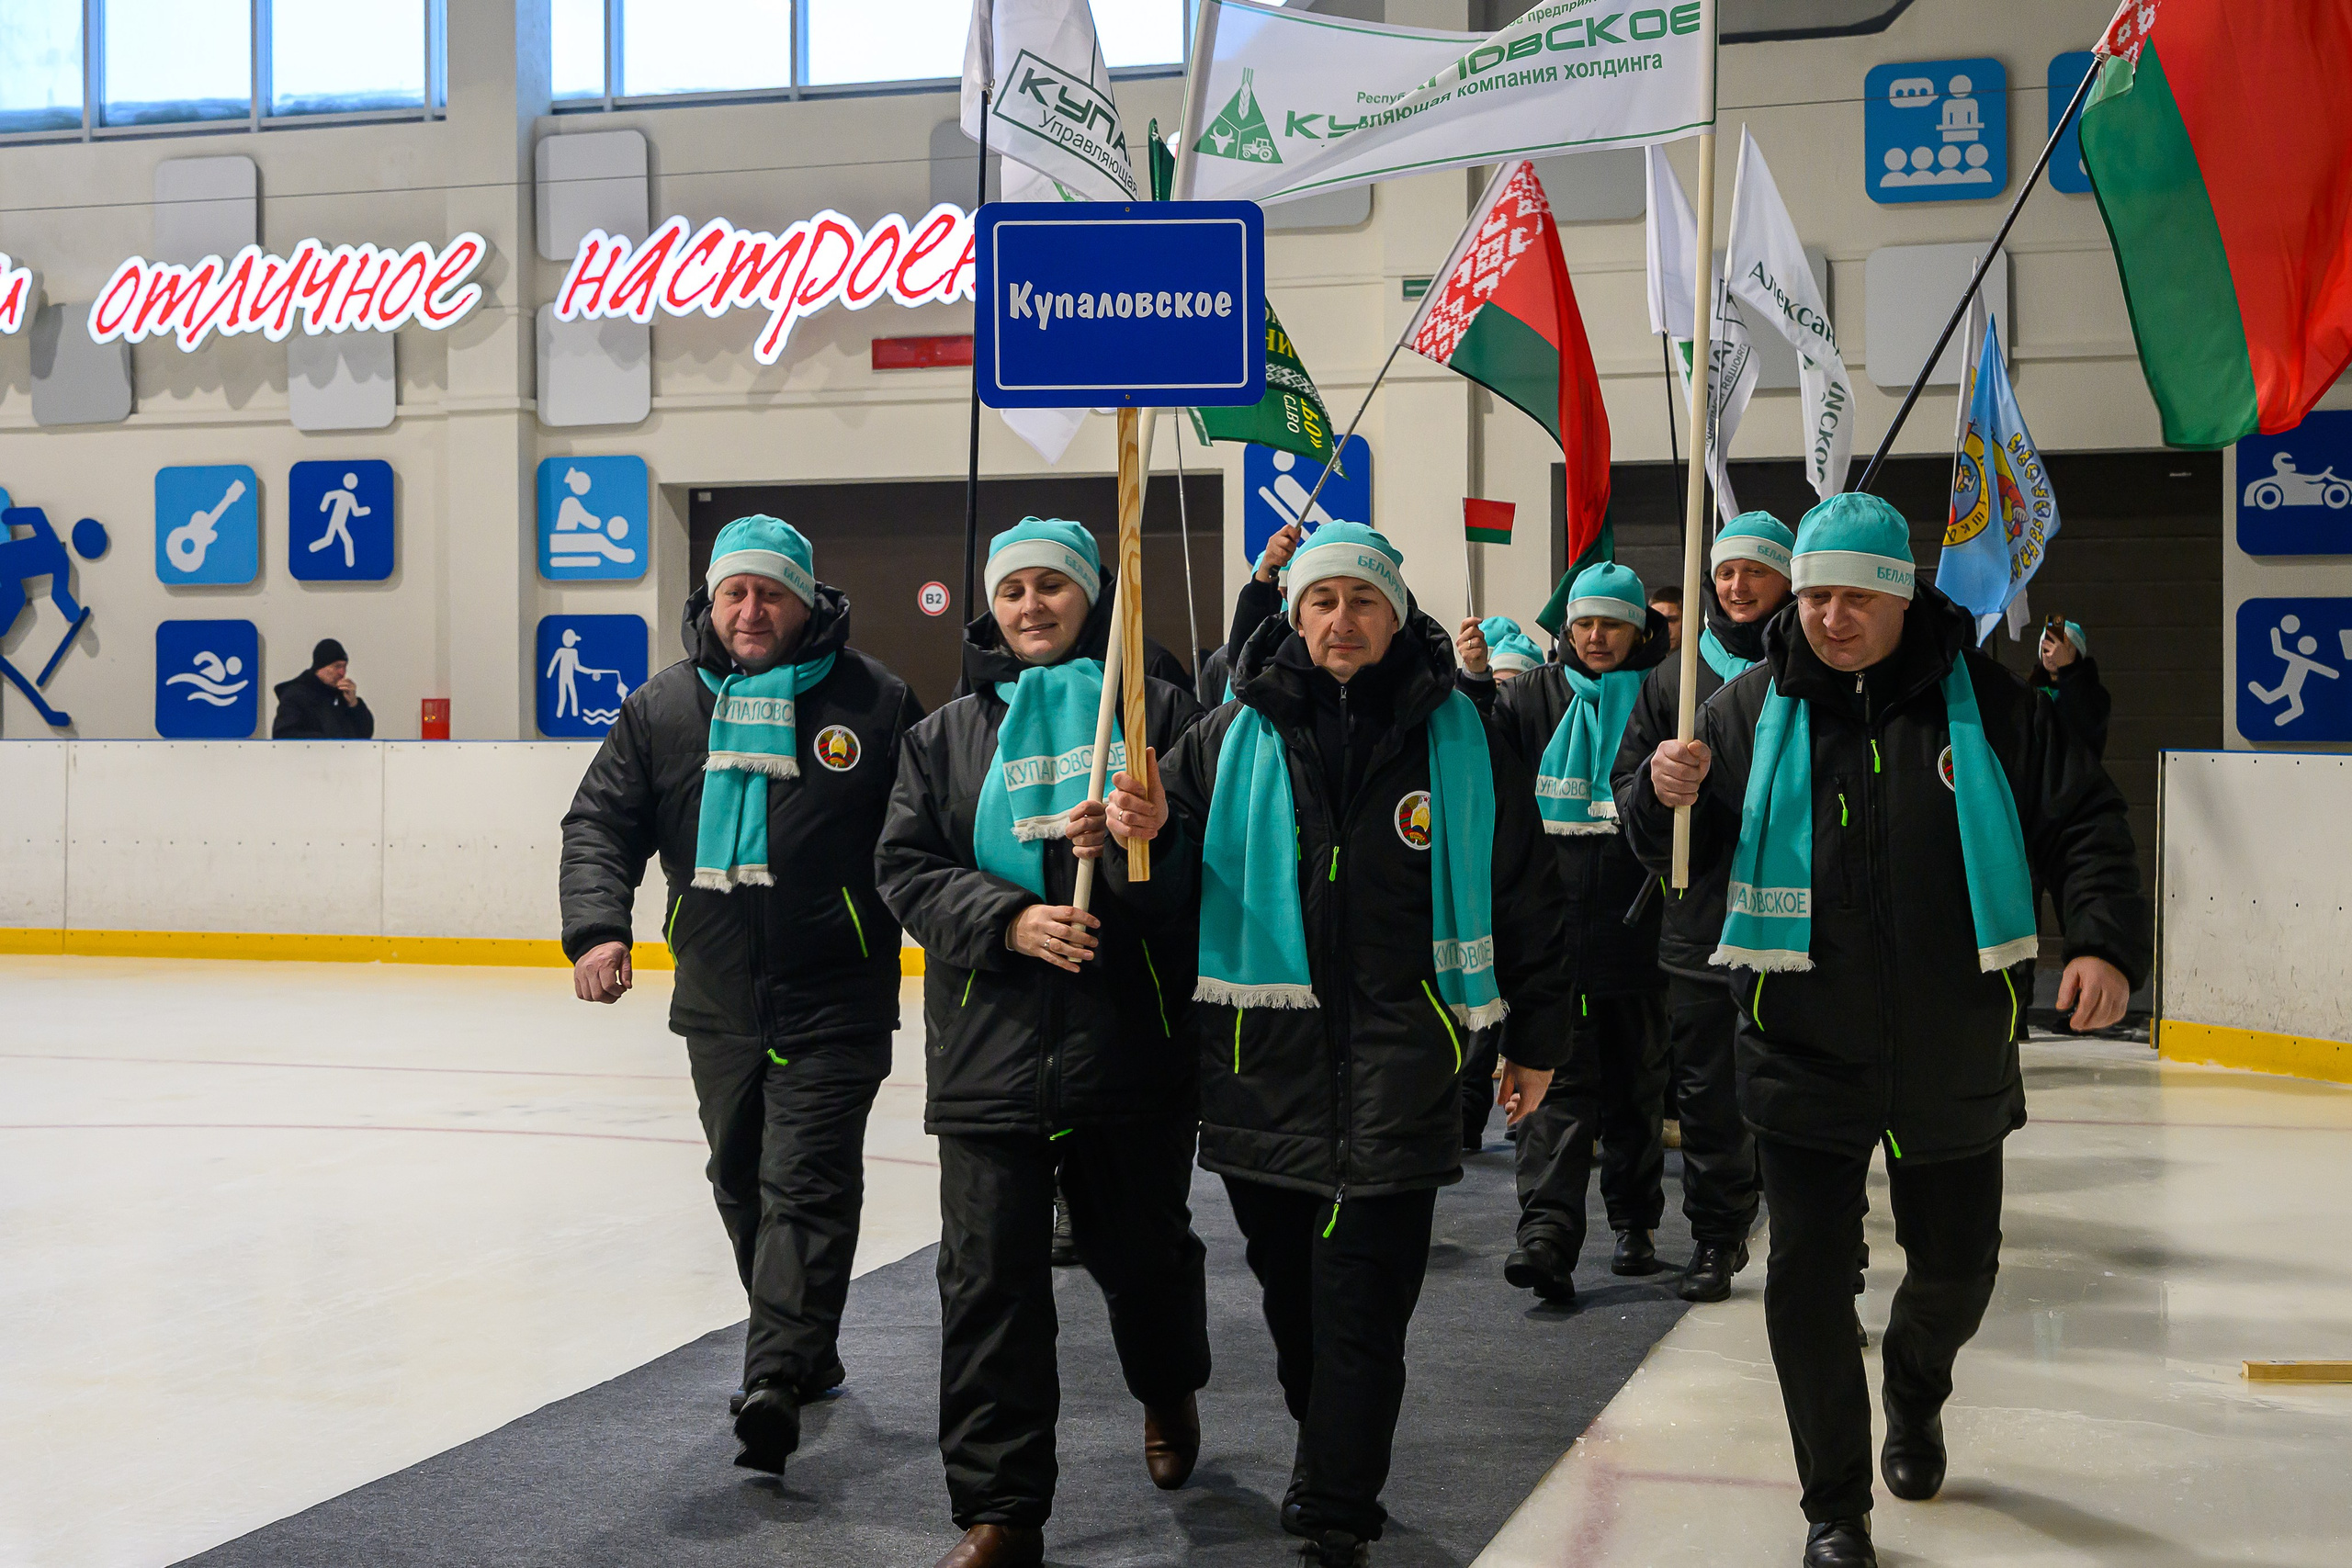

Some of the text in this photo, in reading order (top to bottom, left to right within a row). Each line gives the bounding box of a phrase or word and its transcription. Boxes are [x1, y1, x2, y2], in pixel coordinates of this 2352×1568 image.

[1019, 67, 1132, 167] КУПА
[1457, 66, 1558, 99] компания
[1564, 52, 1663, 81] холдинга
[1038, 109, 1137, 196] Управляющая
[97, 242, 478, 344] отличное
[1009, 280, 1233, 331] Купаловское
[1748, 261, 1841, 356] Алексан
[1005, 745, 1126, 787] КУПАЛОВСОЕ
